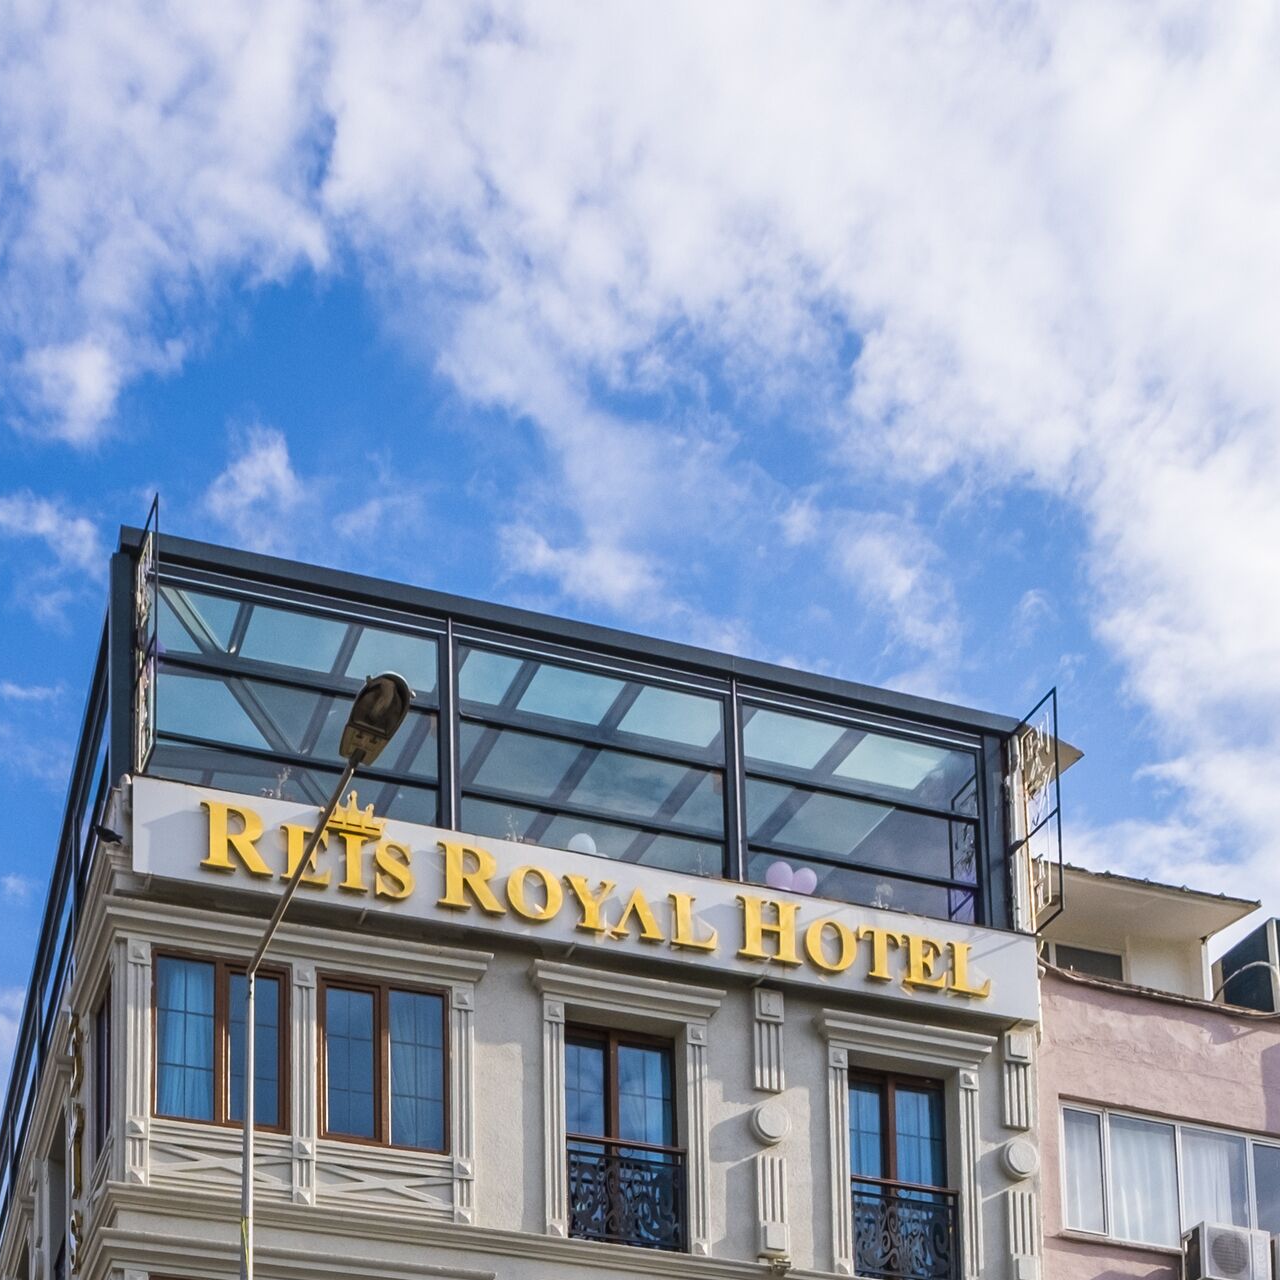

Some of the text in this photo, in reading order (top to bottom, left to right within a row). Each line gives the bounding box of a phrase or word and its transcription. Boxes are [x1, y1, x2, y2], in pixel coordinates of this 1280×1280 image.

[199, 797, 993, 998] REIS ROYAL HOTEL
